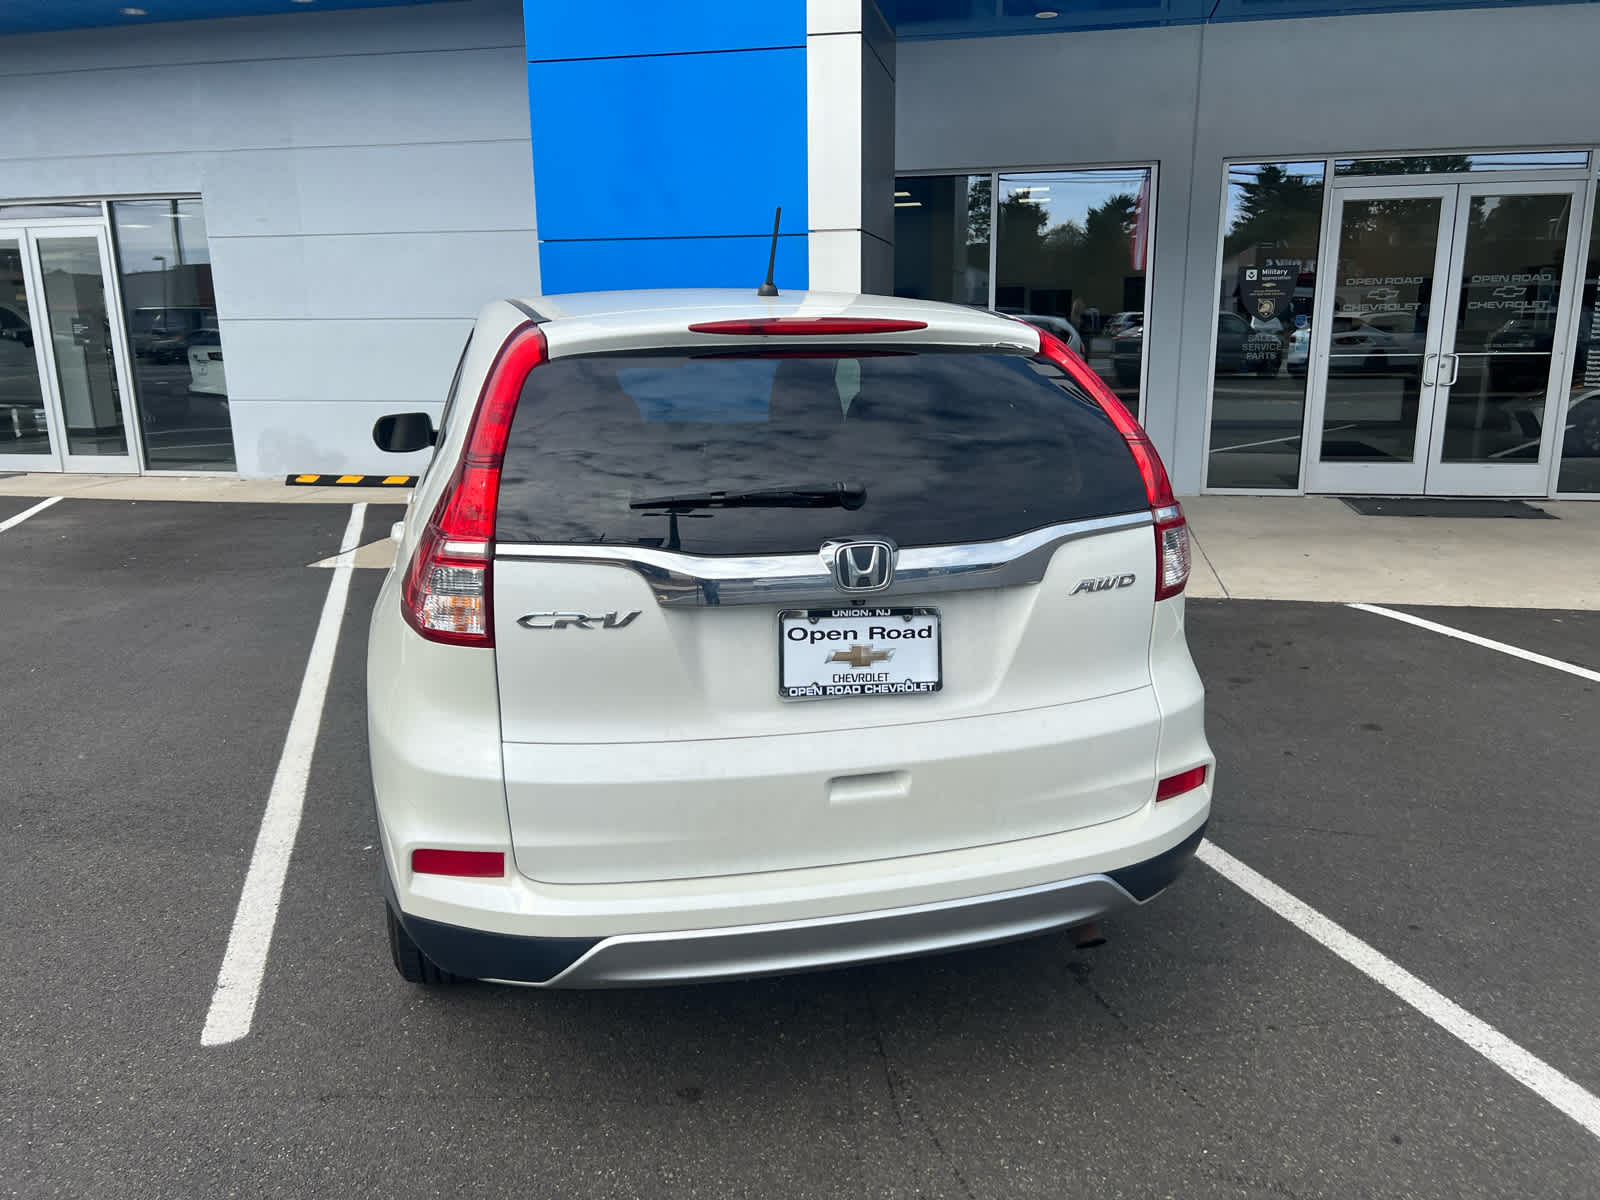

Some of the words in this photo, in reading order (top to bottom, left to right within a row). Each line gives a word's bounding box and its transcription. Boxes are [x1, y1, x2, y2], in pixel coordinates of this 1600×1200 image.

[1346, 278, 1383, 286] OPEN
[1385, 277, 1424, 285] ROAD
[1472, 275, 1509, 283] OPEN
[1511, 274, 1552, 282] ROAD
[1343, 303, 1422, 312] CHEVROLET
[1467, 300, 1549, 309] CHEVROLET
[1246, 352, 1277, 360] PARTS
[1068, 573, 1136, 596] AWD
[832, 609, 872, 617] UNION,
[876, 609, 891, 617] NJ
[516, 611, 643, 630] CR-V
[787, 627, 858, 644] Open
[869, 625, 932, 640] Road
[833, 673, 890, 683] CHEVROLET
[789, 685, 825, 696] OPEN
[827, 684, 861, 695] ROAD
[864, 682, 935, 694] CHEVROLET
